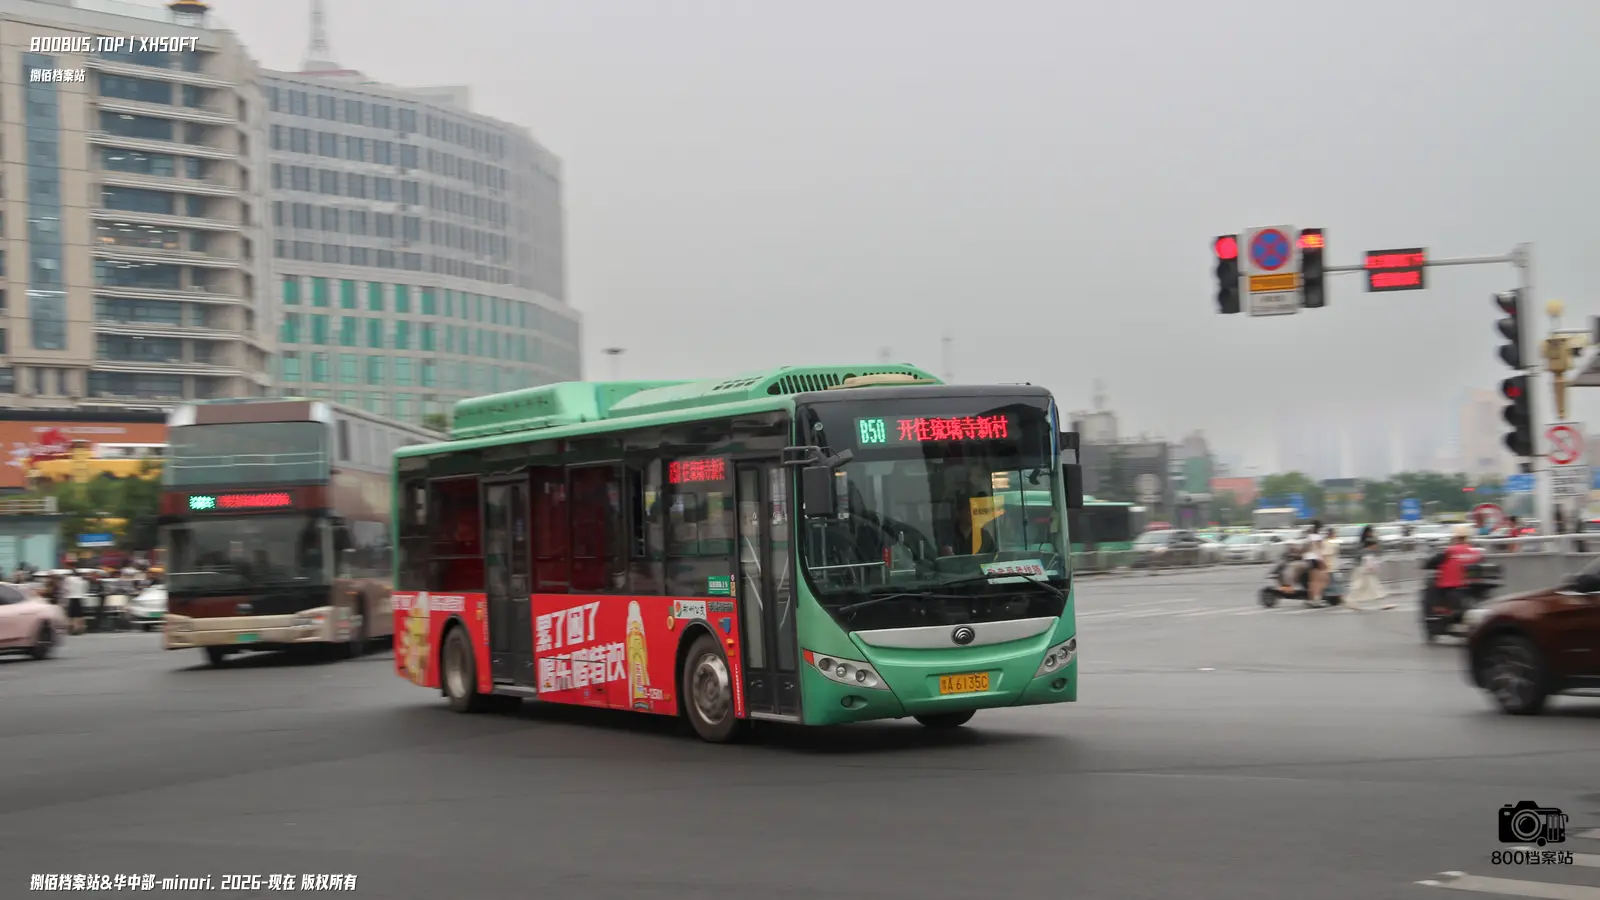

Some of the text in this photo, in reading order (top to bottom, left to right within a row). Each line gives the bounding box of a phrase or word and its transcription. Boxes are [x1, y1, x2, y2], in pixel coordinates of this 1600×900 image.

[859, 418, 886, 444] B50
[896, 415, 1009, 441] 开往琉璃寺新村
[536, 601, 600, 652] 累了困了
